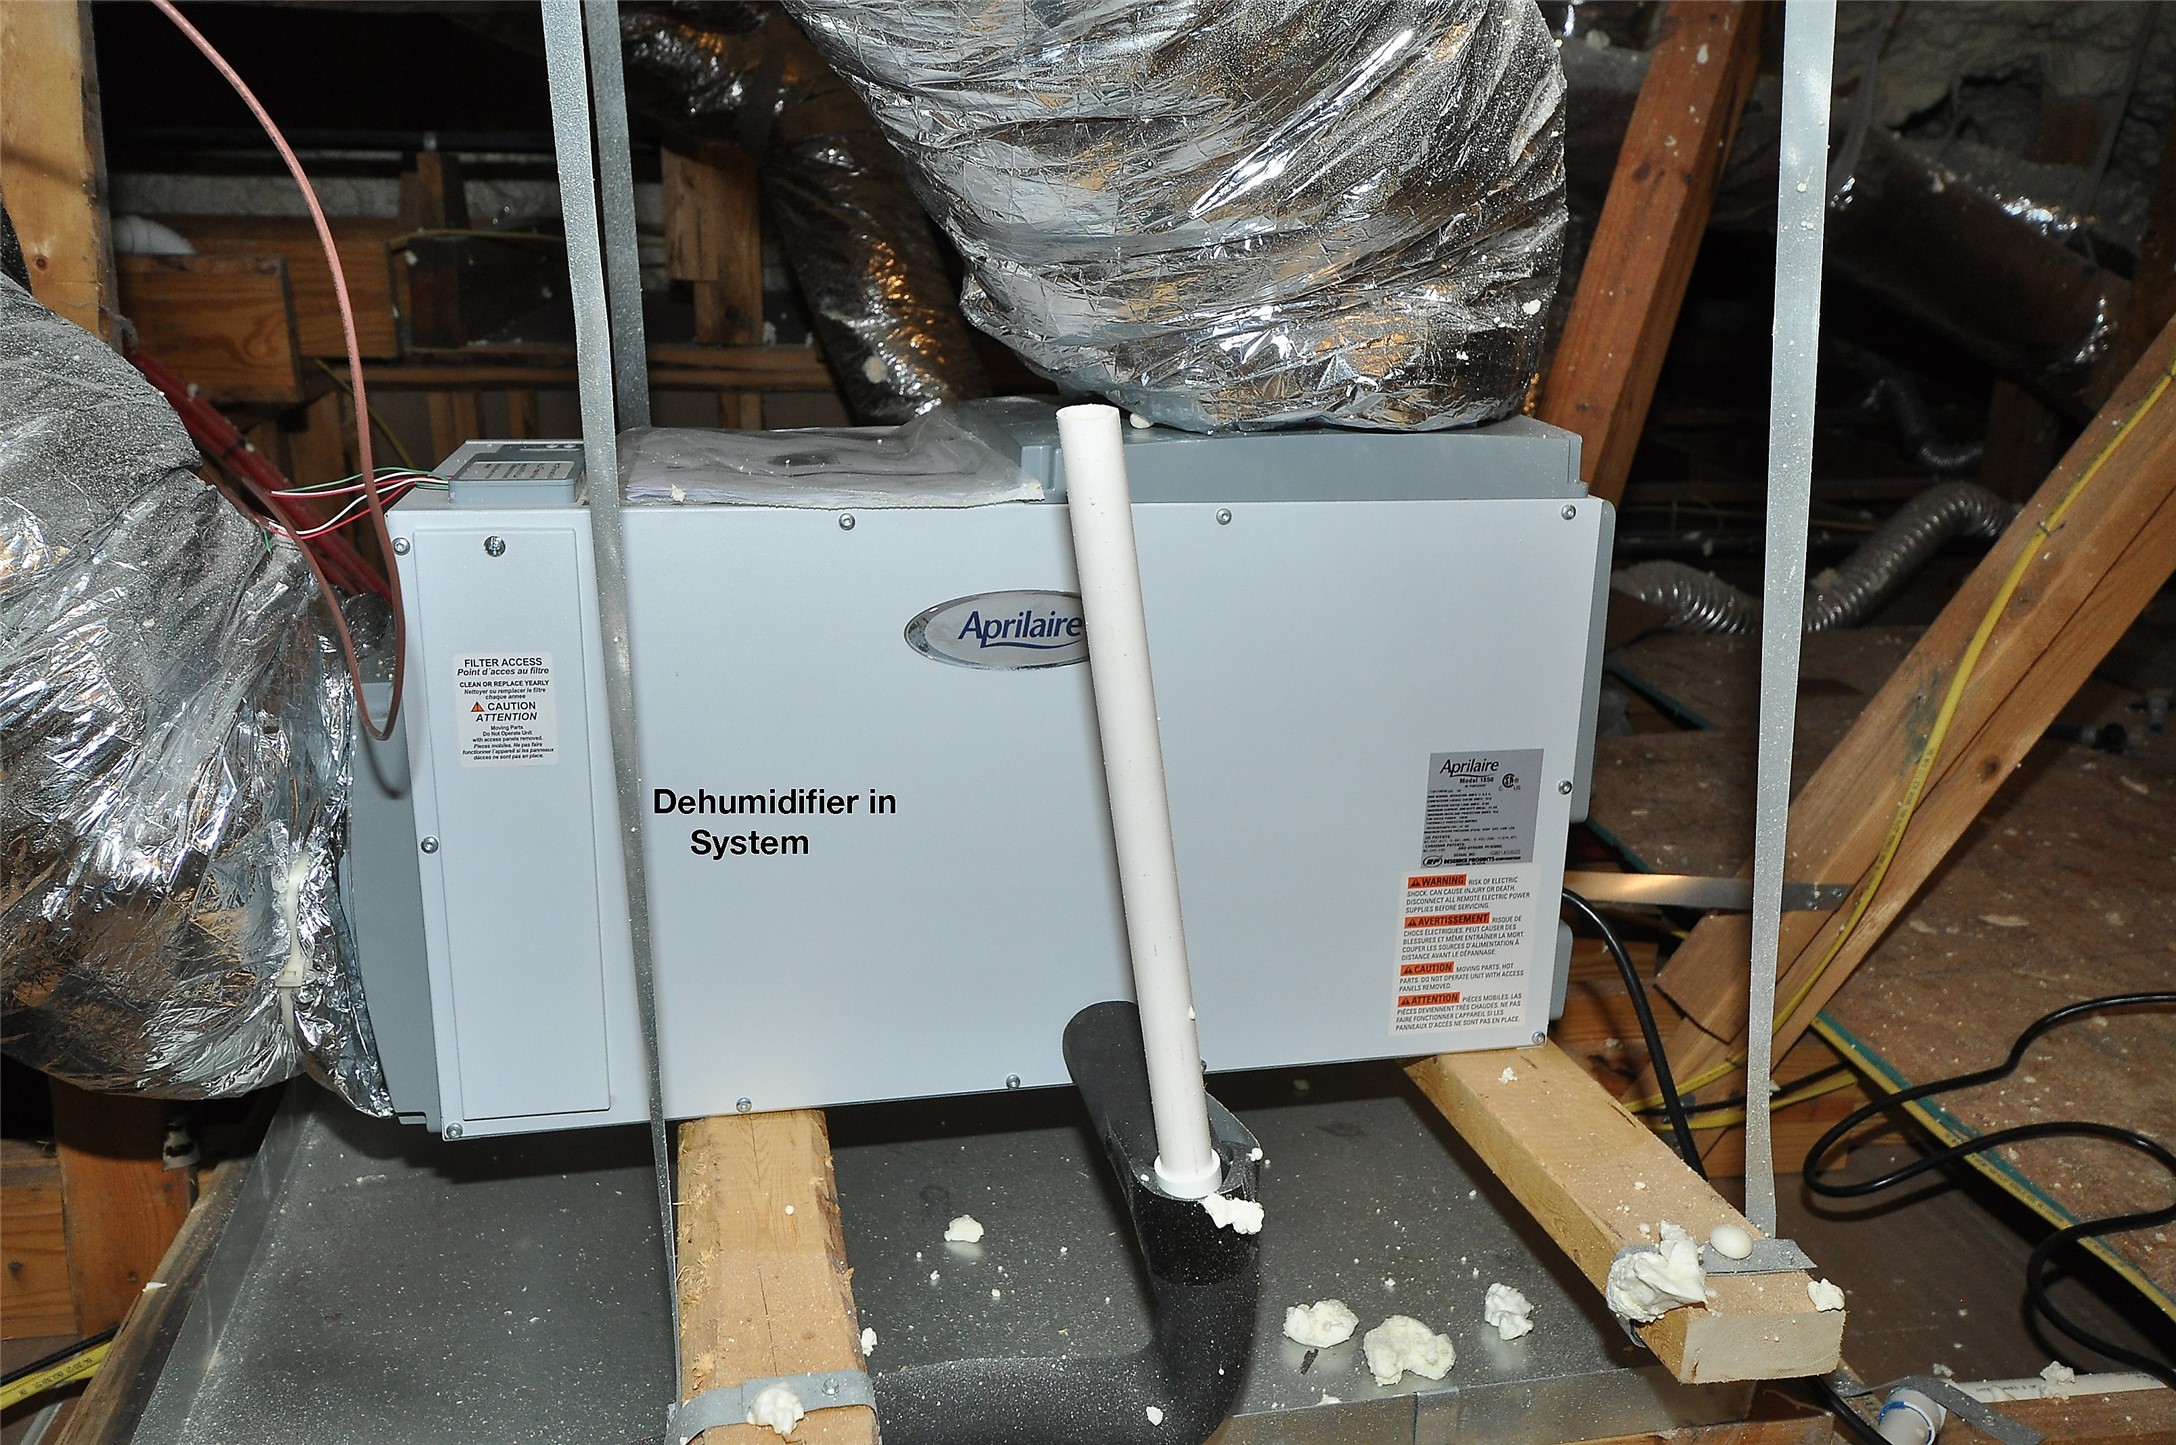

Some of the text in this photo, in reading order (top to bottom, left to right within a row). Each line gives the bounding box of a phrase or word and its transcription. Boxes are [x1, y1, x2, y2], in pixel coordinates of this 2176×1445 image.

[957, 611, 1083, 648] Aprilaire
[465, 658, 542, 667] FILTER ACCESS
[488, 702, 535, 710] CAUTION
[476, 712, 537, 722] ATTENTION
[1440, 759, 1499, 777] Aprilaire
[1422, 876, 1464, 886] WARNING
[1406, 897, 1443, 905] DISCONNECT
[1418, 914, 1488, 926] AVERTISSEMENT
[1481, 924, 1504, 932] CAUSER
[1446, 934, 1464, 942] MÊME
[1465, 932, 1497, 940] ENTRAÎNER
[1466, 940, 1513, 948] D'ALIMENTATION
[1414, 963, 1452, 973] CAUTION
[1412, 994, 1458, 1004] ATTENTION
[1414, 1014, 1454, 1022] FONCTIONNER
[1396, 1023, 1427, 1031] PANNEAUX
